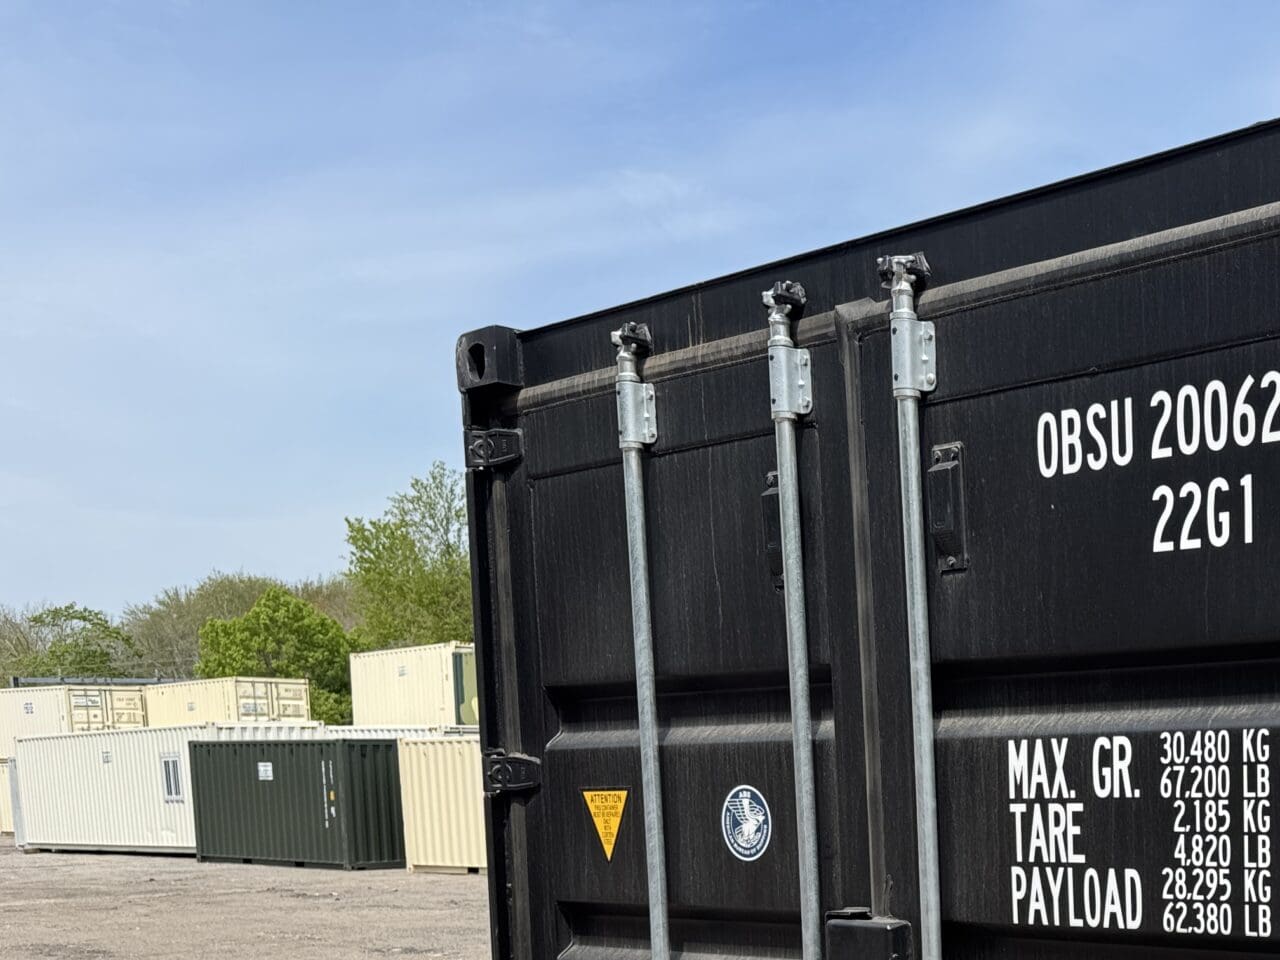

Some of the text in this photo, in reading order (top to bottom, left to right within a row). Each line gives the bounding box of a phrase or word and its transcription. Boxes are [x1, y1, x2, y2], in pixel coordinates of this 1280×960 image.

[1037, 397, 1134, 478] OBSU
[1152, 473, 1253, 553] 22G1
[1160, 728, 1270, 764] 30,480 KG
[1007, 736, 1141, 799] MAX. GR.
[1160, 764, 1270, 798] 67,200 LB
[590, 793, 622, 804] ATTENTION
[1173, 800, 1271, 833] 2,185 KG
[1009, 803, 1086, 863] TARE
[1174, 834, 1271, 868] 4,820 LB
[1011, 866, 1143, 930] PAYLOAD
[1162, 867, 1271, 903] 28,295 KG
[1163, 902, 1272, 937] 62,380 LB
